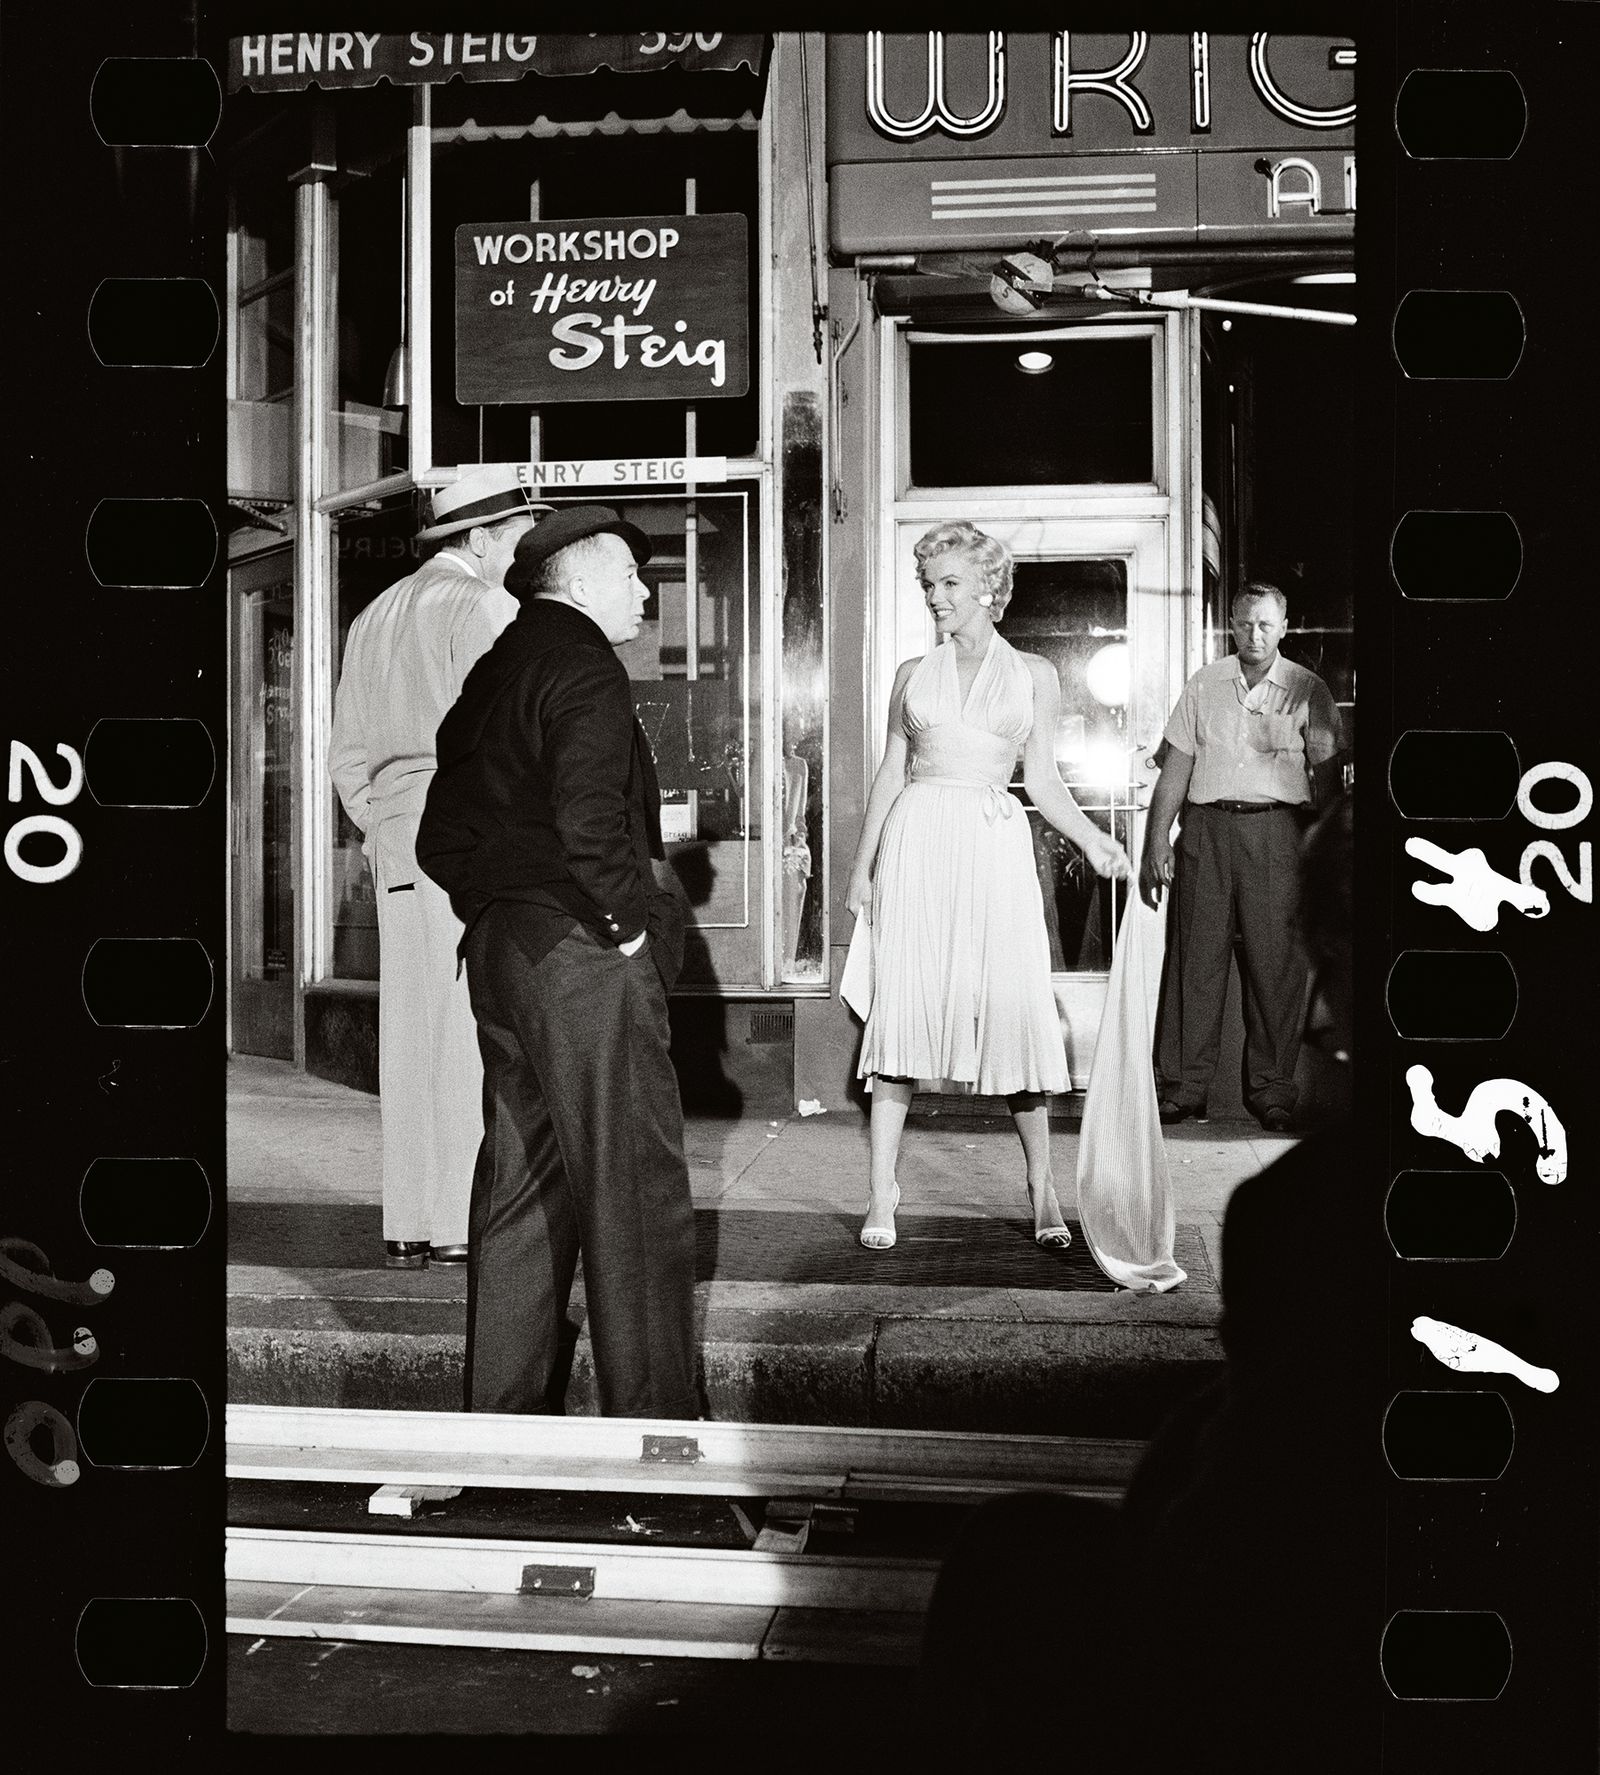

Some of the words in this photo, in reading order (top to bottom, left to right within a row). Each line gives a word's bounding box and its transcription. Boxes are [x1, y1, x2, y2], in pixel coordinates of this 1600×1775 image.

[242, 31, 381, 76] HENRY
[409, 32, 537, 67] STEIG
[1267, 157, 1357, 219] A
[473, 228, 680, 265] WORKSHOP
[489, 279, 515, 306] of
[530, 271, 657, 316] Henry
[548, 312, 726, 387] Steig
[613, 461, 686, 482] STEIG
[4, 740, 84, 884] 20
[1517, 761, 1594, 905] 20
